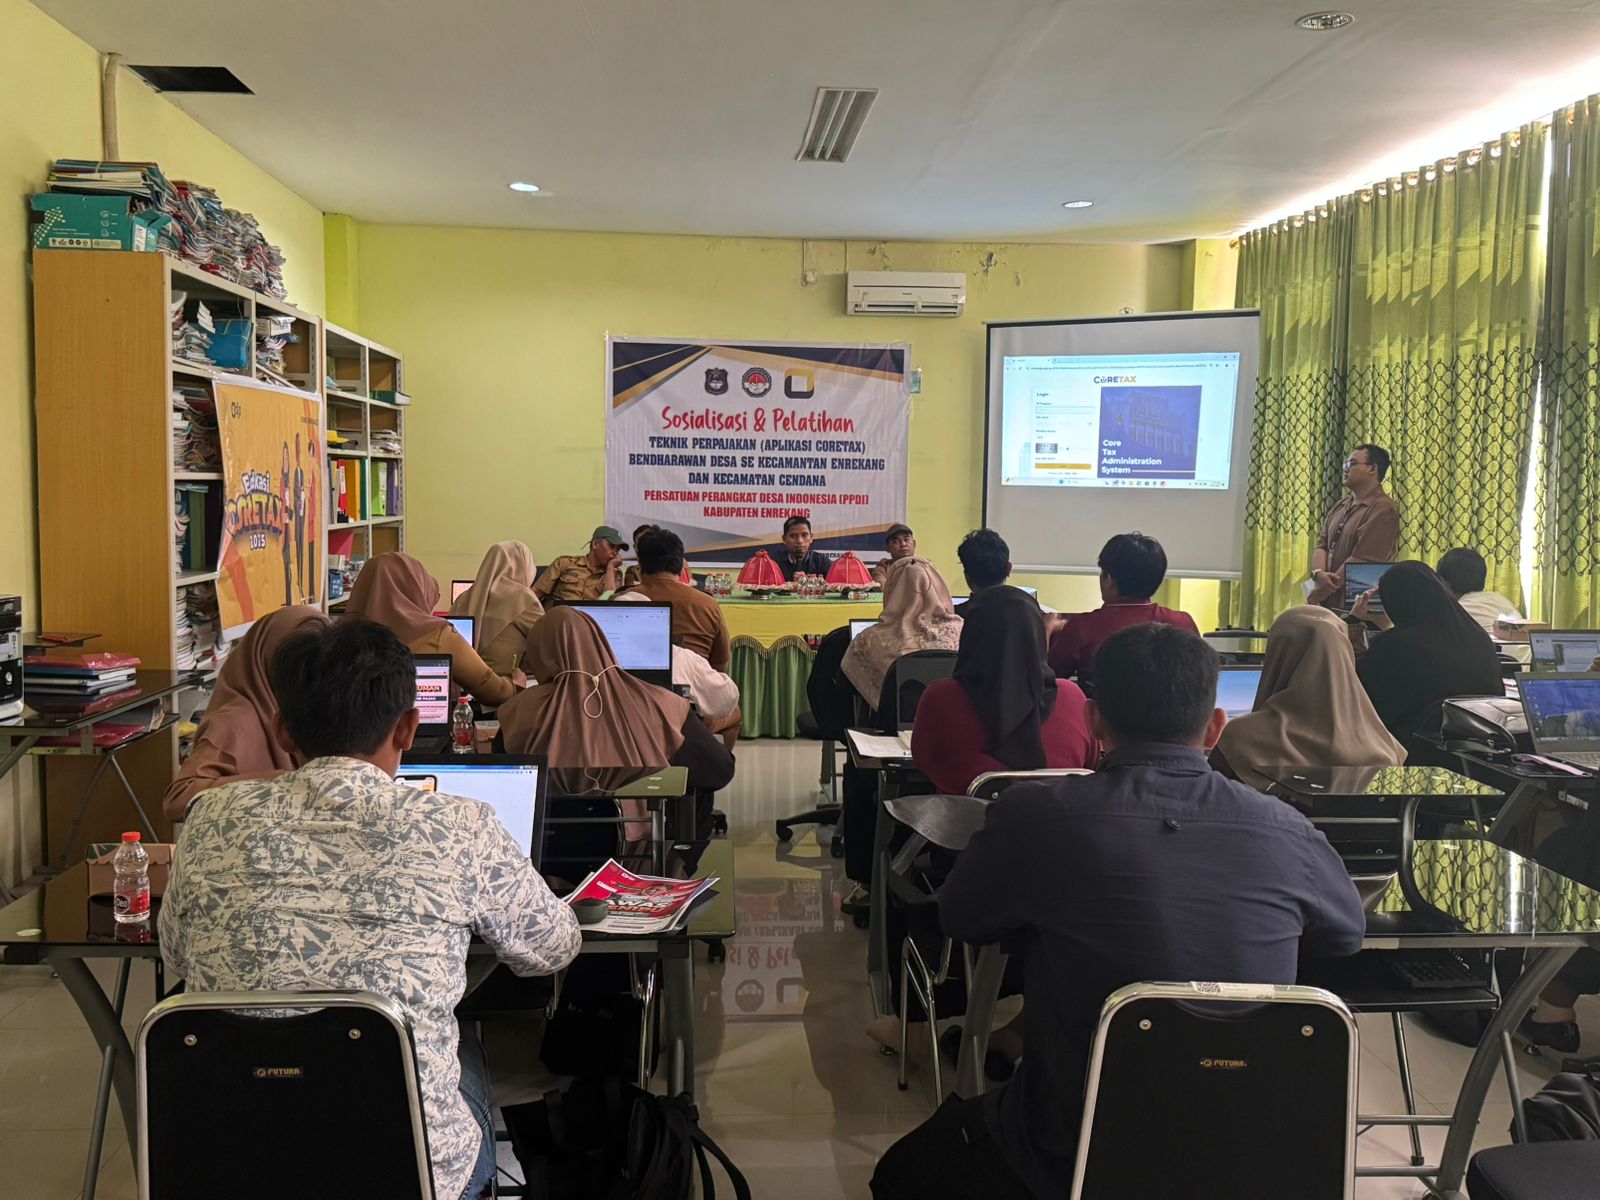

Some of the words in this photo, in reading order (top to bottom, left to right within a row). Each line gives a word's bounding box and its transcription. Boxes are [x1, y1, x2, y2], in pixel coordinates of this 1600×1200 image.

[661, 405, 747, 432] Sosialisasi
[753, 407, 766, 432] &
[772, 408, 855, 433] Pelatihan
[649, 436, 688, 449] TEKNIK
[692, 437, 756, 450] PERPAJAKAN
[760, 439, 812, 453] (APLIKASI
[815, 440, 866, 455] CORETAX)
[1102, 439, 1122, 447] Core
[629, 453, 706, 467] BENDHARAWAN
[710, 455, 737, 468] DESA
[740, 456, 754, 468] SE
[758, 456, 827, 469] KECAMANTAN
[831, 457, 885, 471] ENREKANG
[1101, 457, 1162, 465] Administration
[1101, 466, 1132, 475] System
[688, 472, 709, 485] DAN
[713, 473, 775, 486] KECAMATAN
[778, 474, 826, 487] CENDANA
[644, 490, 699, 502] PERSATUAN
[702, 491, 757, 503] PERANGKAT
[760, 492, 784, 504] DESA
[786, 493, 837, 505] INDONESIA
[703, 506, 758, 518] KABUPATEN
[761, 508, 810, 519] ENREKANG
[268, 1067, 300, 1075] FUTURA
